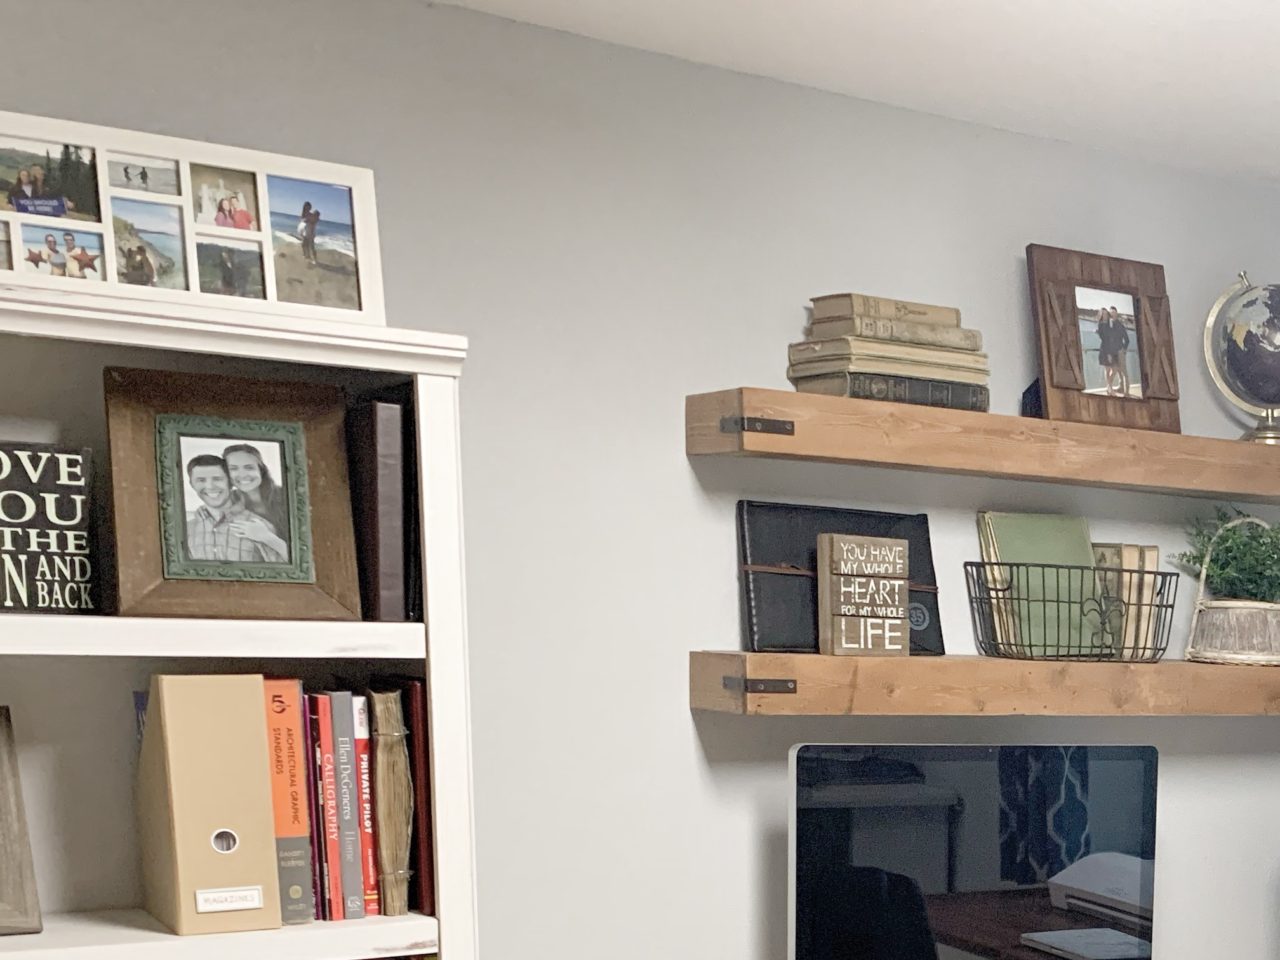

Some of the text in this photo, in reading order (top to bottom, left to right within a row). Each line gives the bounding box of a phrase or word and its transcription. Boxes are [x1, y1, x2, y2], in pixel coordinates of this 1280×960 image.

[841, 542, 904, 563] YOU HAVE
[35, 554, 92, 582] AND
[841, 561, 904, 575] MY WHOLE
[35, 581, 95, 609] BACK
[841, 577, 905, 605] HEART
[841, 605, 905, 618] FOR MY WHOLE
[841, 617, 902, 650] LIFE
[272, 727, 284, 775] STANDARDS
[286, 727, 301, 825] ARCHITECTURAL GRAPHIC
[324, 753, 338, 841] CALLIGRAPHY
[338, 736, 356, 862] Ellen DeGeneres Home
[360, 753, 373, 834] PRIVATE PILOT
